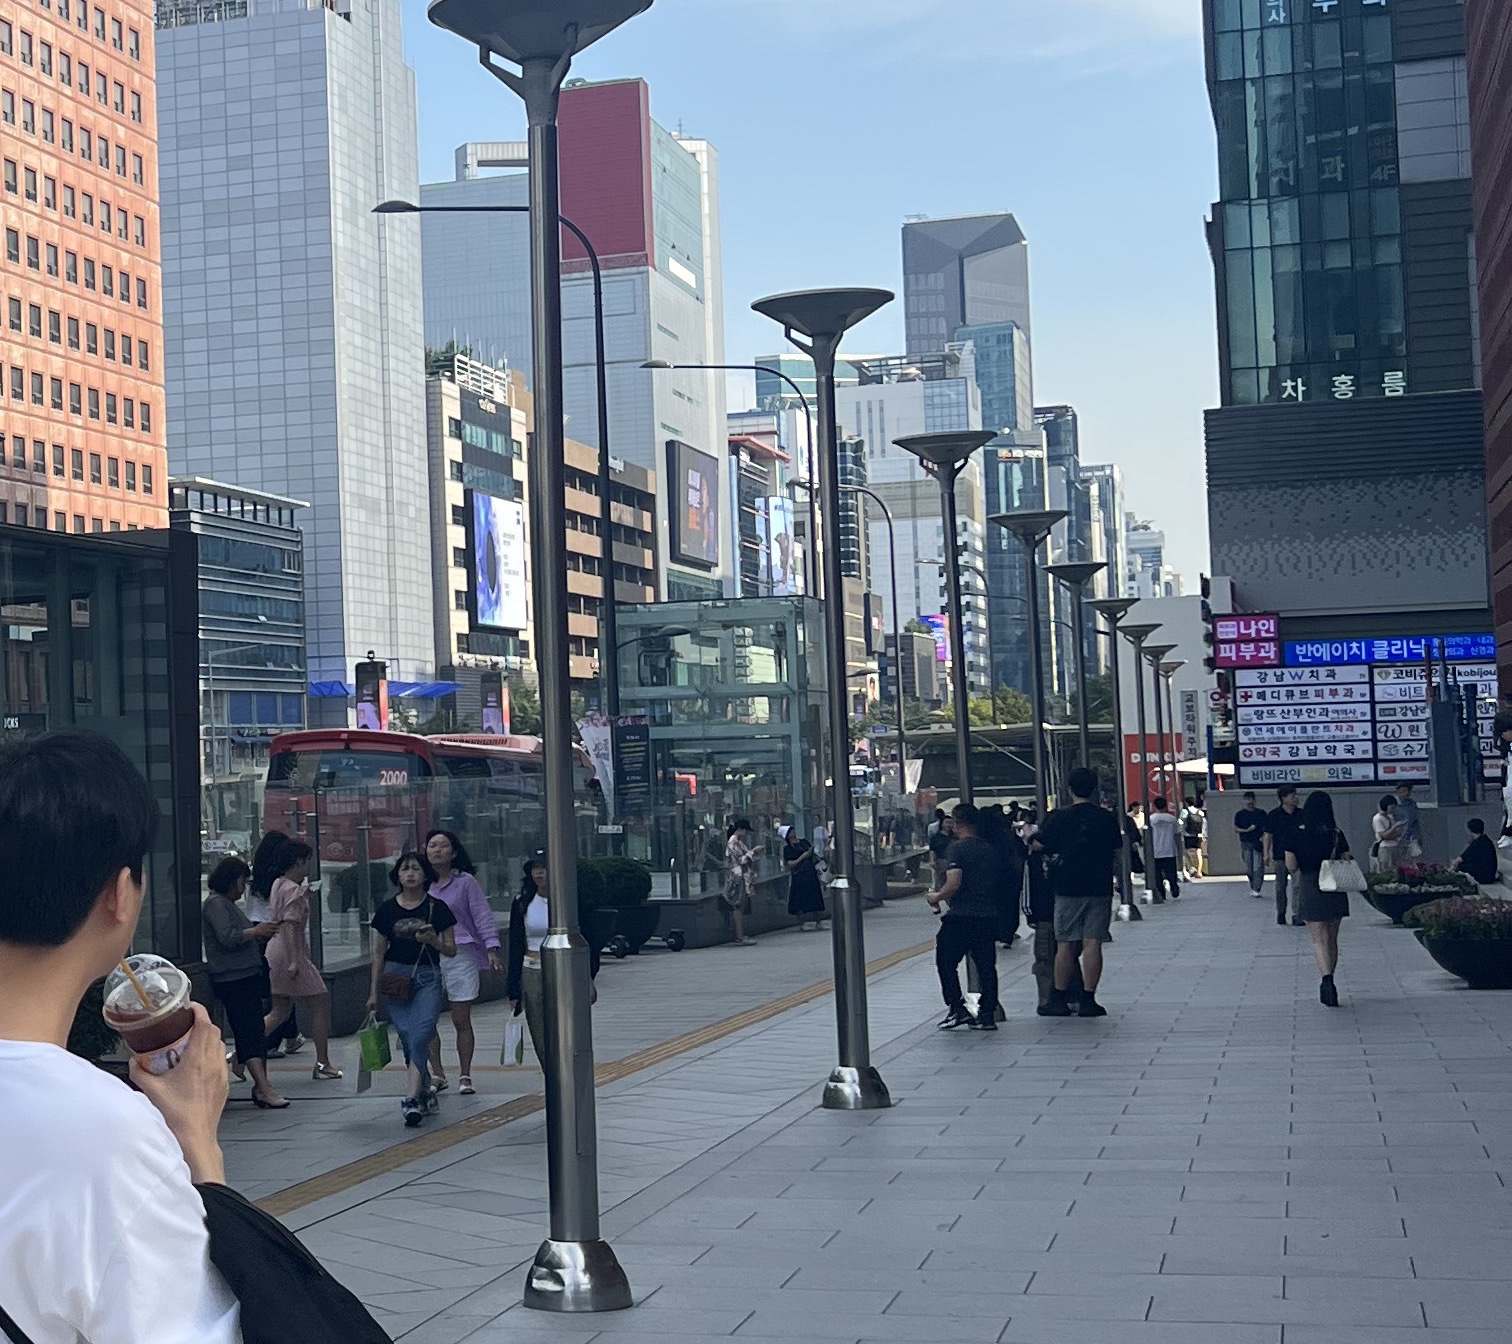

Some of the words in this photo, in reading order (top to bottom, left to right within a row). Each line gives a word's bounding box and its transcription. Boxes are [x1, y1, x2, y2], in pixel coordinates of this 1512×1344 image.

[1239, 619, 1276, 638] 나인
[1218, 641, 1278, 662] 피부과
[1295, 641, 1367, 662] 반에이치
[1371, 638, 1426, 660] 클리닉
[1457, 667, 1497, 679] kobijou
[1314, 688, 1355, 699] 피부과
[1254, 745, 1281, 758] 약국
[1288, 743, 1356, 758] 강남약국
[379, 770, 408, 786] 2000
[1251, 768, 1301, 782] 비비라인
[1327, 766, 1353, 780] 의원
